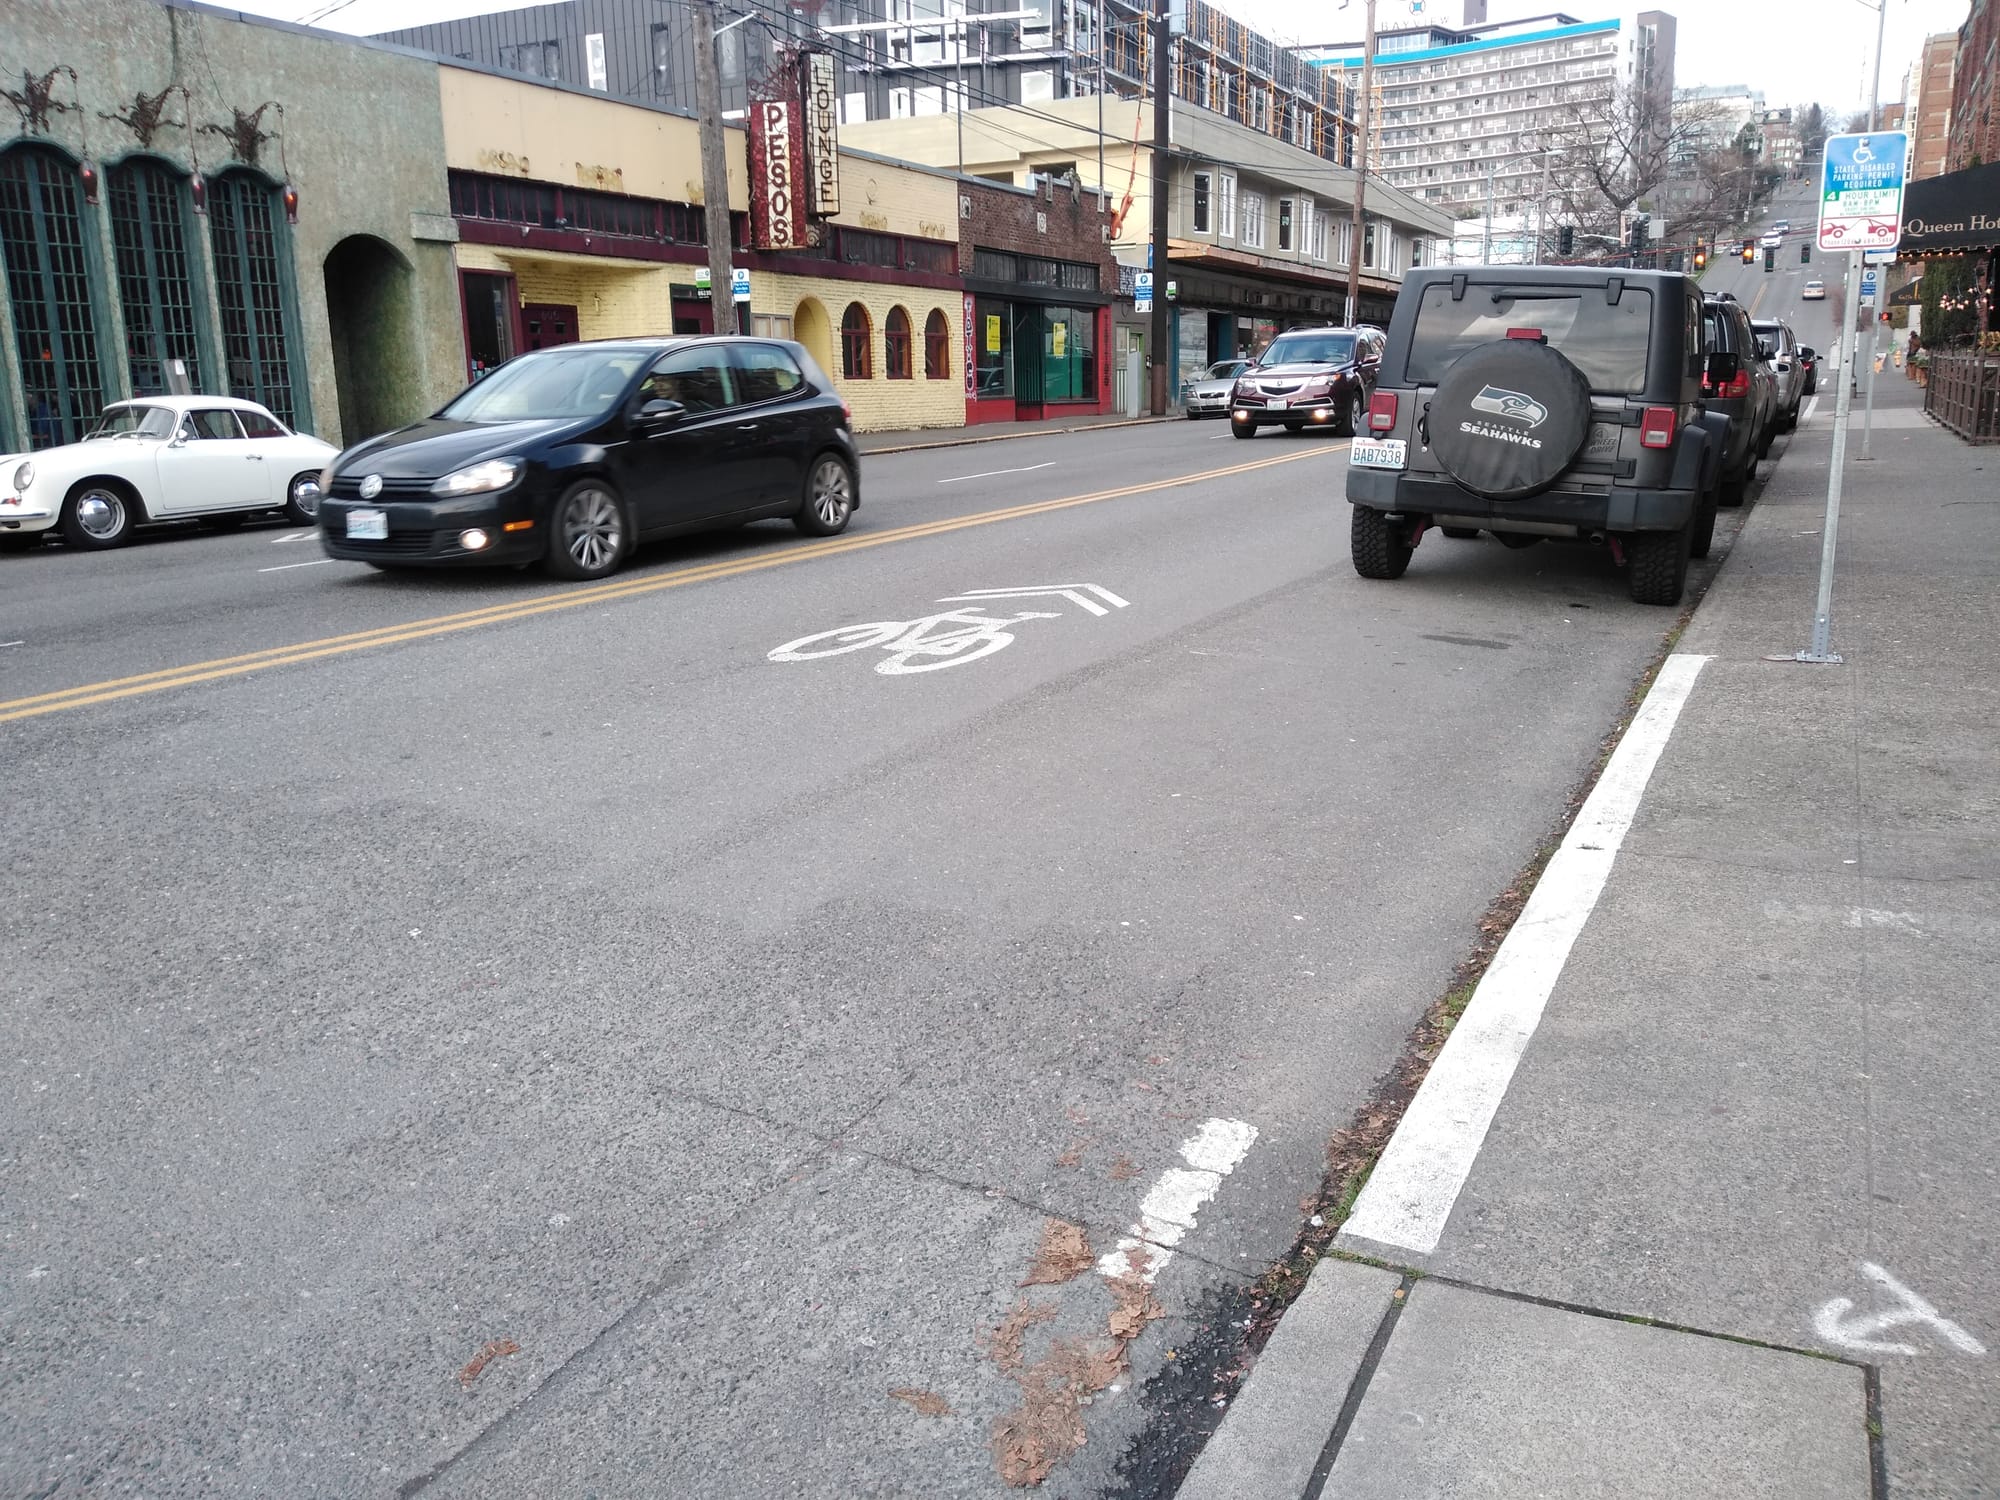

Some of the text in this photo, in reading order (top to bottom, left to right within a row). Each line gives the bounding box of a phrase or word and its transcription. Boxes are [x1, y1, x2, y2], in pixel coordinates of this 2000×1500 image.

[1381, 17, 1448, 32] BAYVIEW
[812, 65, 833, 203] LOUNGE
[766, 104, 789, 244] PESOS
[1833, 163, 1896, 173] STATE DISABLED
[1833, 171, 1895, 181] PARKING PERMIT
[1844, 180, 1883, 189] REQUIRED
[1827, 190, 1897, 201] 4 HOUR LIMIT
[1901, 218, 1964, 237] rQueen
[1460, 422, 1542, 448] SEAHAWKS
[1476, 420, 1530, 436] SEATTLE
[1590, 438, 1618, 447] WHEEL
[1590, 445, 1616, 454] DRIVE
[1353, 447, 1402, 464] BAB7938
